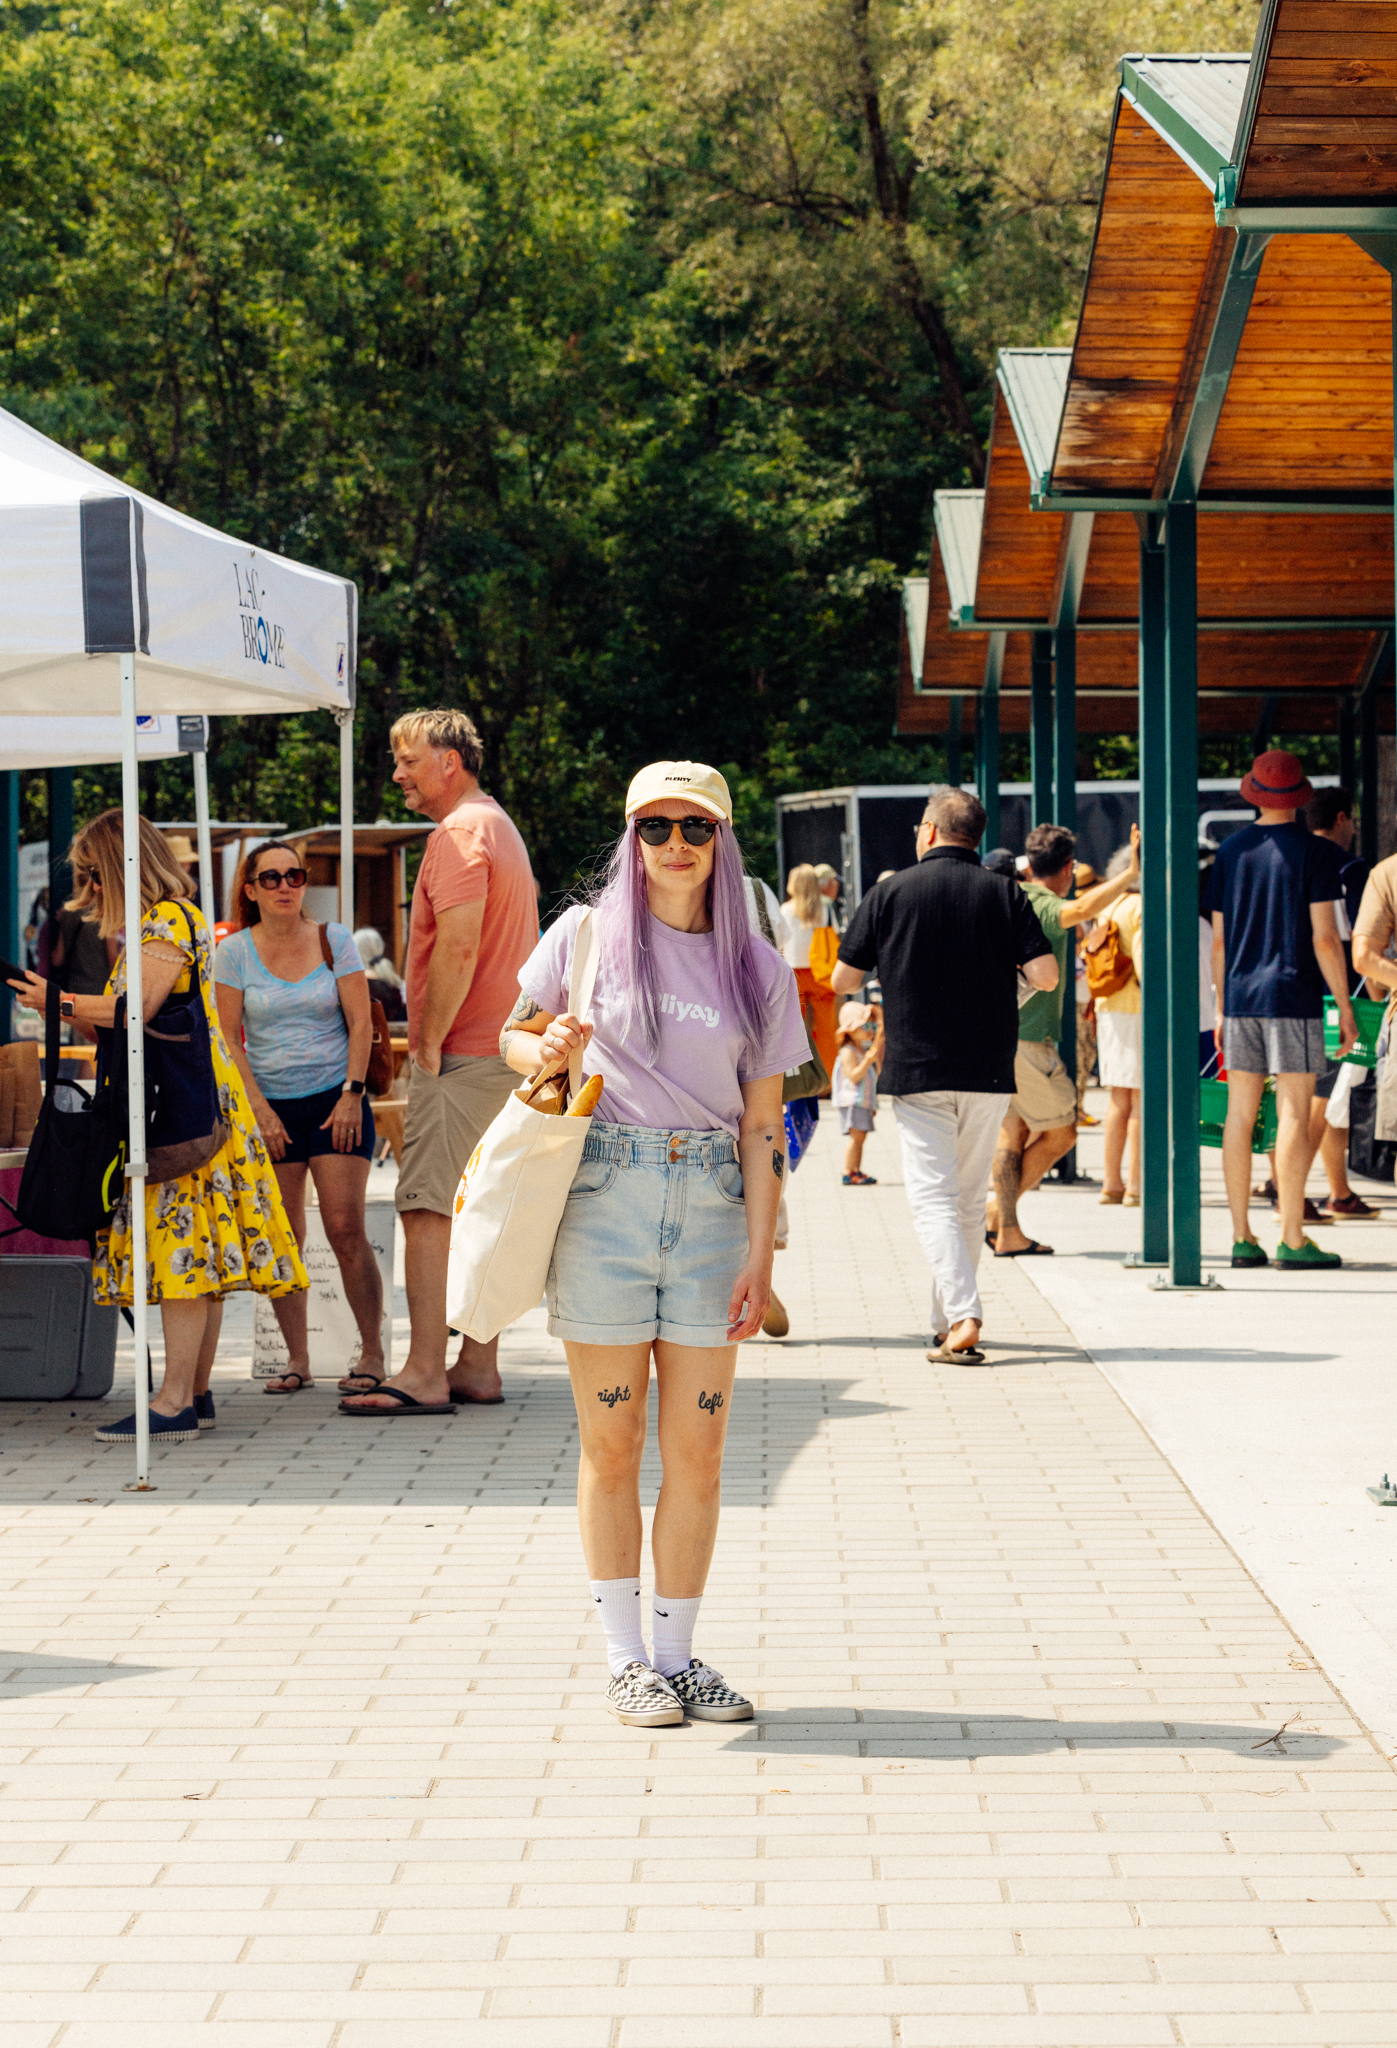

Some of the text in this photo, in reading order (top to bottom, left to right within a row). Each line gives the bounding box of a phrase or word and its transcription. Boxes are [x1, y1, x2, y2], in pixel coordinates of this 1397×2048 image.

[240, 614, 286, 669] BROME
[658, 992, 720, 1028] liyay
[597, 1385, 632, 1408] right
[698, 1390, 724, 1415] left
